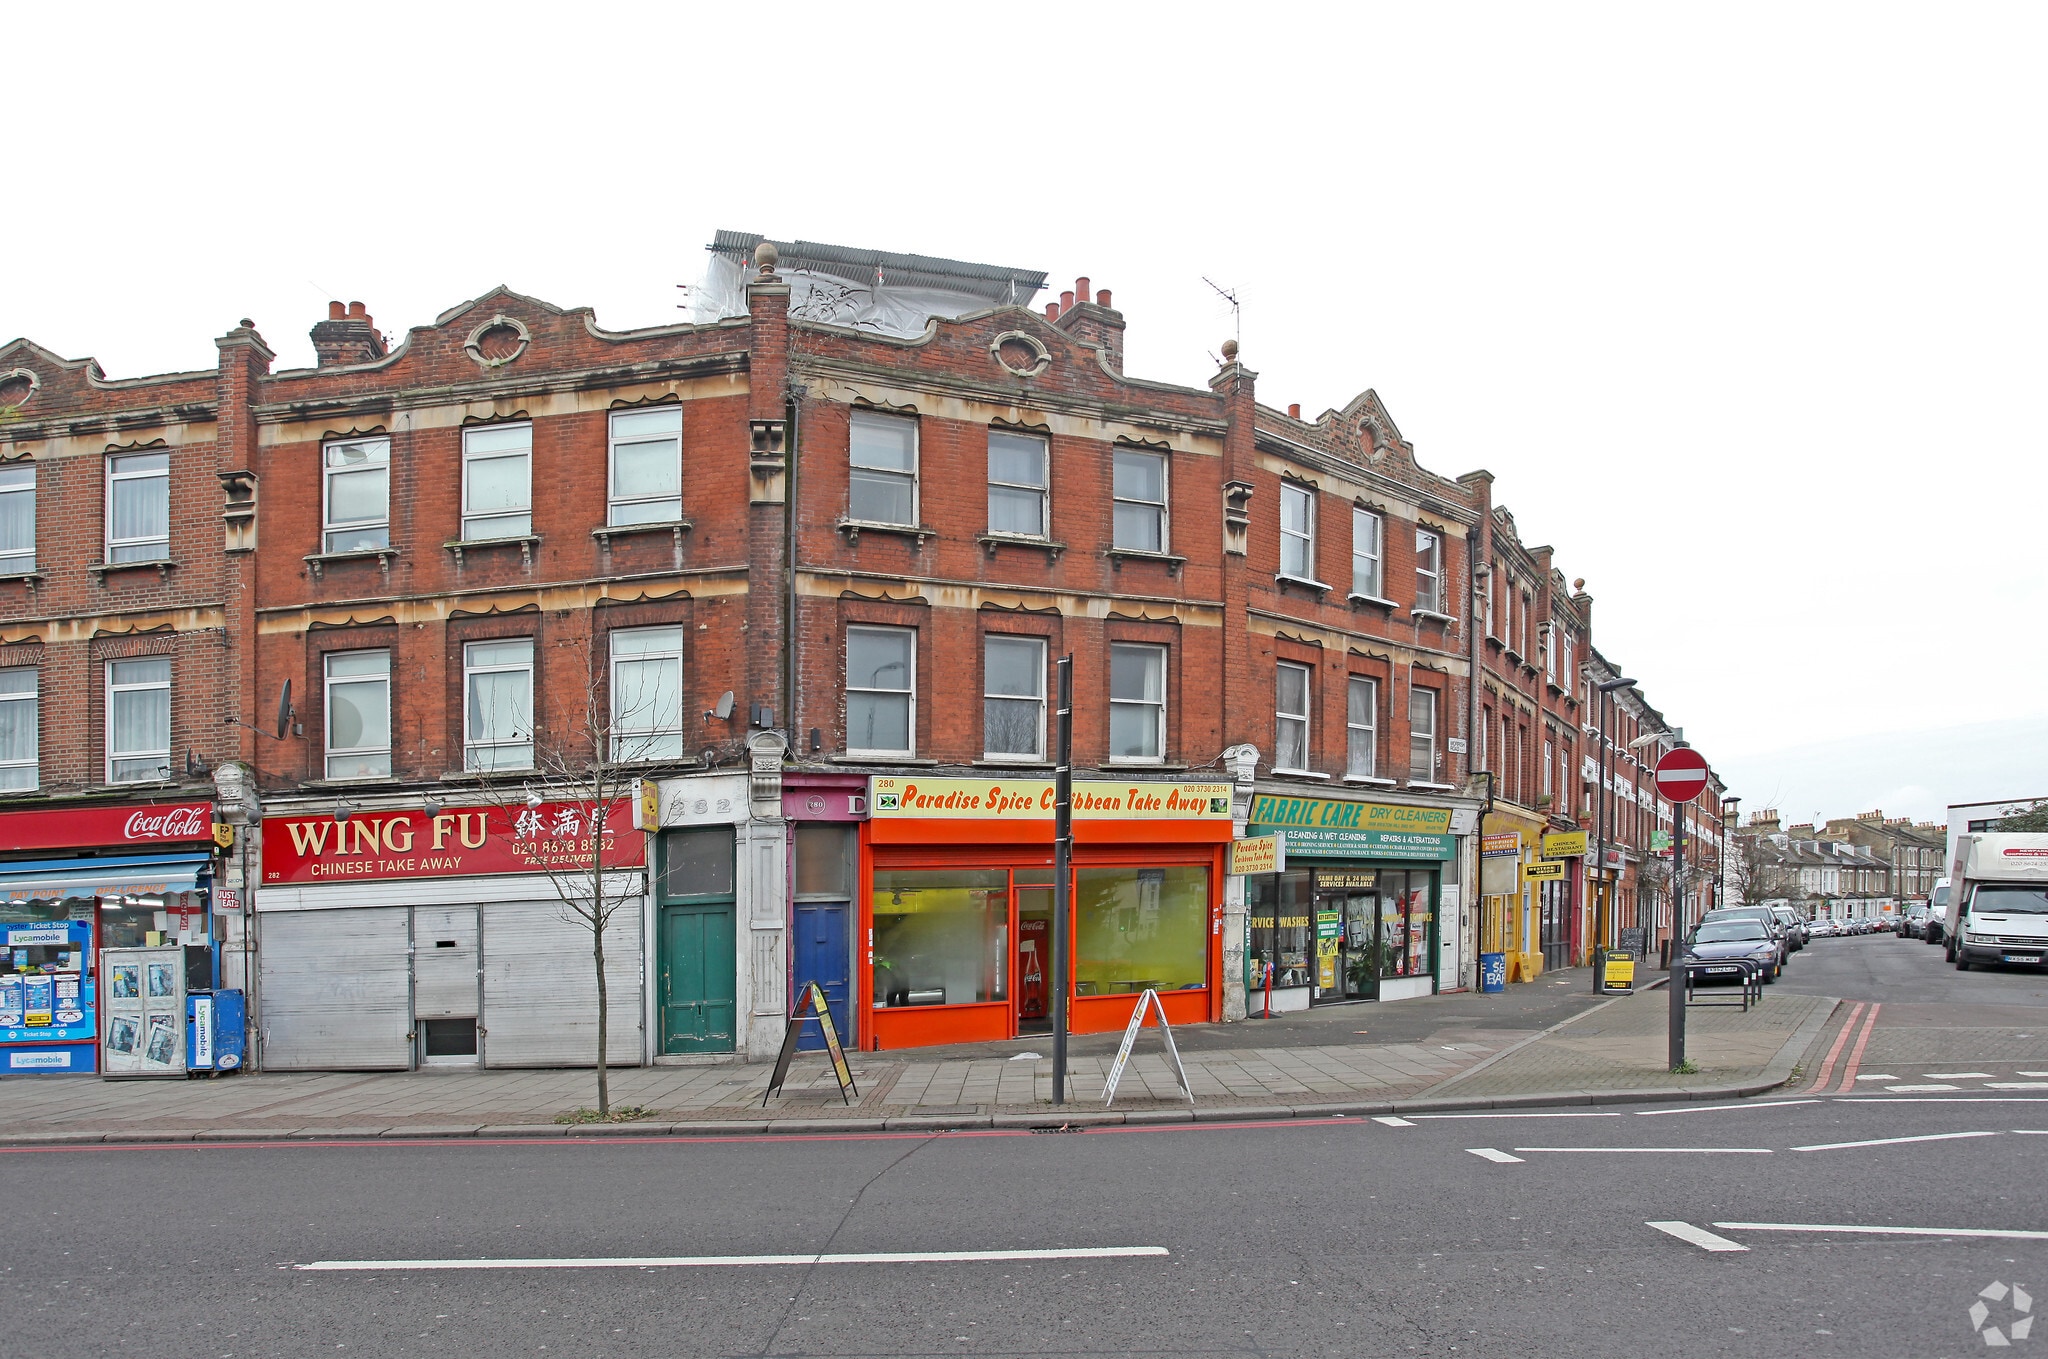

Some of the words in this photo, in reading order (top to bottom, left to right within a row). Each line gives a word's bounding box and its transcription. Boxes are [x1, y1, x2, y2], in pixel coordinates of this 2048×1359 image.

[878, 780, 894, 788] 280
[900, 784, 980, 809] Paradise
[985, 786, 1032, 814] Spice
[1040, 787, 1120, 810] Cibbean
[1126, 788, 1160, 811] Take
[1166, 788, 1207, 816] Away
[671, 799, 731, 816] 282
[1254, 798, 1318, 825] FABRIC
[1320, 802, 1364, 827] CARE
[1370, 807, 1392, 819] DRY
[1394, 809, 1447, 823] CLEANERS
[124, 808, 205, 839] Coca-Cola
[285, 816, 414, 857] WING
[430, 812, 488, 850] FU
[1380, 835, 1401, 843] REPAIRS
[1407, 836, 1440, 844] ALTERATIONS
[512, 842, 536, 855] 020
[1237, 842, 1258, 852] Paradise
[1259, 839, 1272, 852] Spice
[311, 860, 373, 876] CHINESE
[378, 858, 415, 872] TAKE
[420, 856, 462, 870] AWAY
[32, 890, 67, 898] POINT
[95, 884, 167, 895] OFF-LICENCE
[218, 891, 236, 899] JUST
[1021, 921, 1045, 930] Coca-Cola
[1251, 917, 1274, 928] RVICE
[1280, 916, 1309, 928] WASHES
[14, 934, 60, 943] Lycamobile
[199, 1005, 207, 1056] Lycamobile
